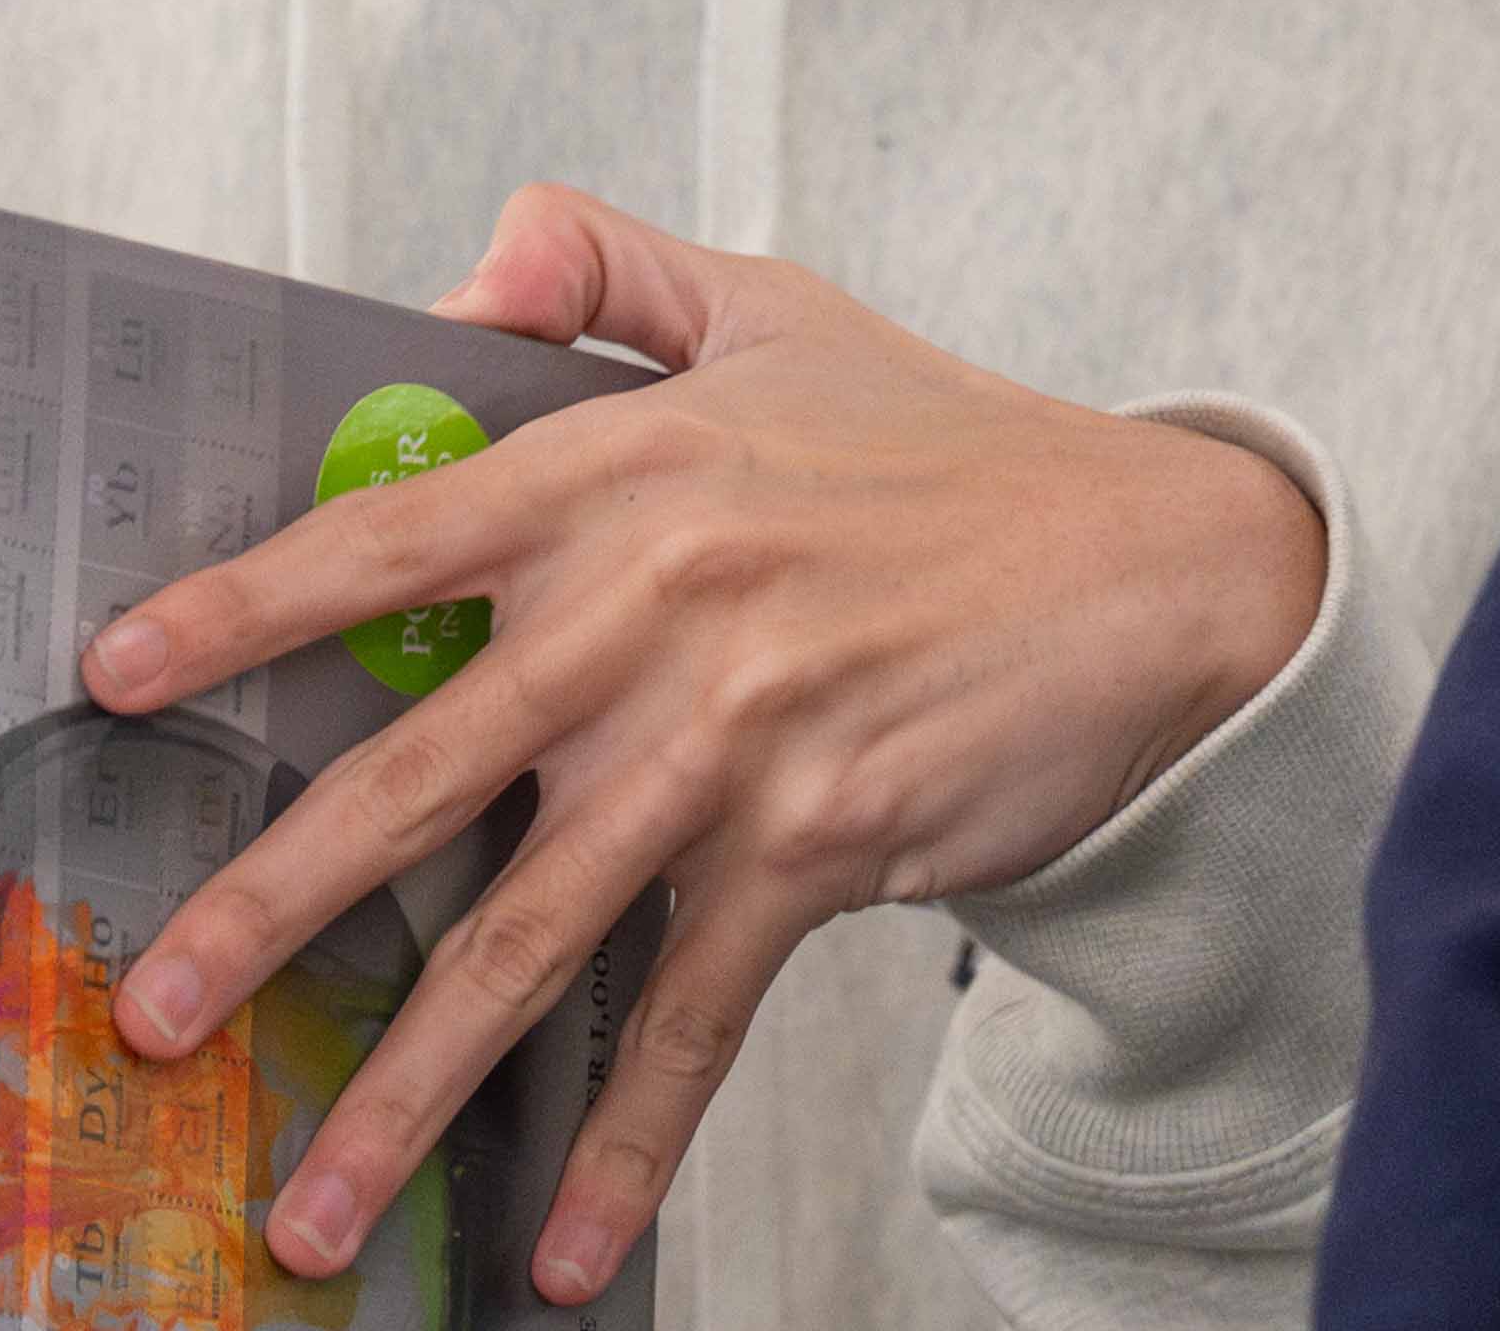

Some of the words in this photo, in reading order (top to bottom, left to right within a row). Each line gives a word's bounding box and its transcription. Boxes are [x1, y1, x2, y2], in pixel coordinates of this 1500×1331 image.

[104, 461, 140, 530] Yb
[82, 916, 113, 991] Ho
[74, 1222, 106, 1292] Tb
